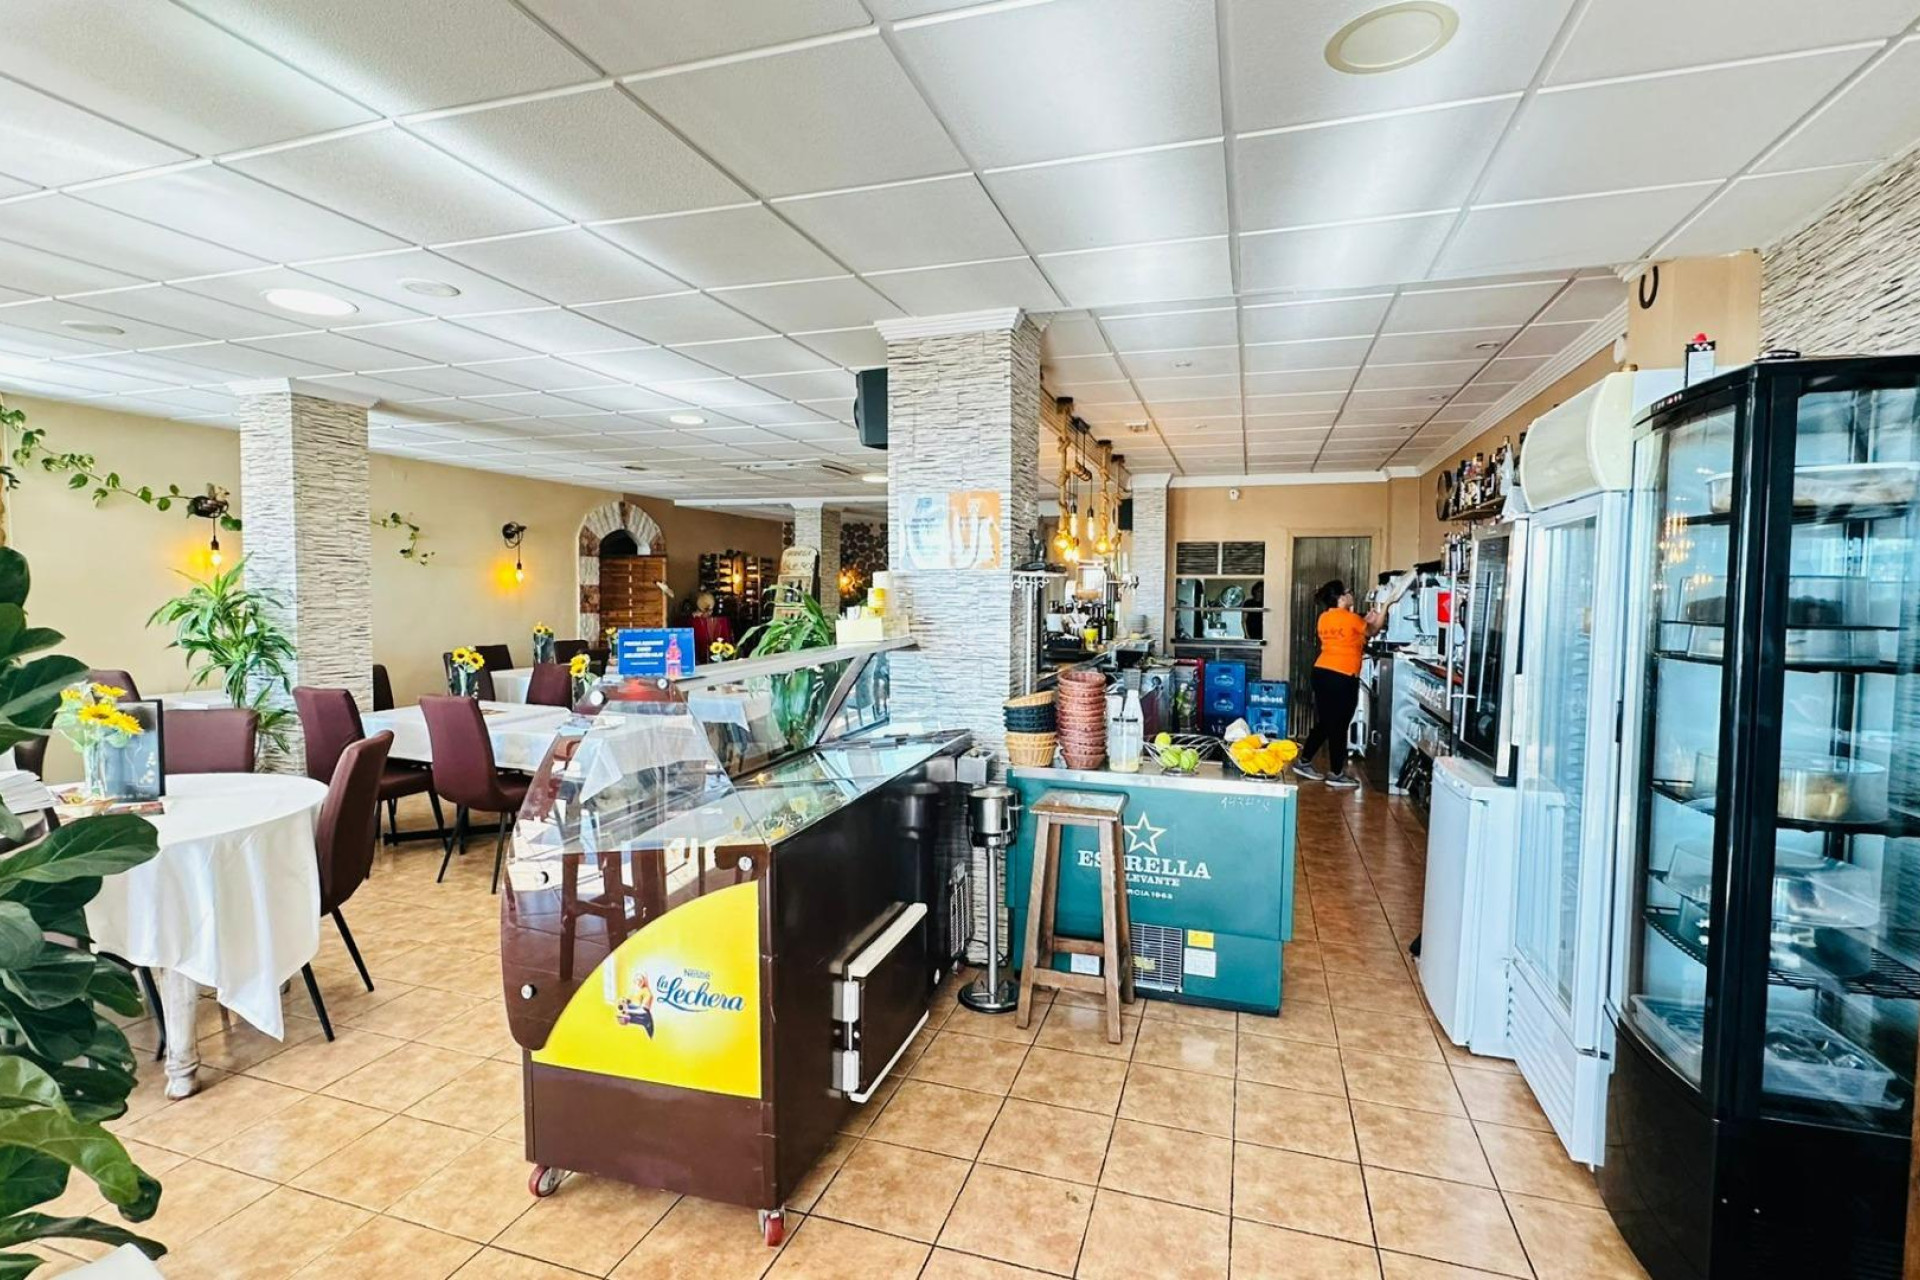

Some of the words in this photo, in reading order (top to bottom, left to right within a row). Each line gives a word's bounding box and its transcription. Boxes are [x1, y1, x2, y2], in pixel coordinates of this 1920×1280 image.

[1077, 850, 1212, 880] ESRELLA
[1126, 873, 1180, 887] LEVANTE
[656, 977, 744, 1012] Lechera
